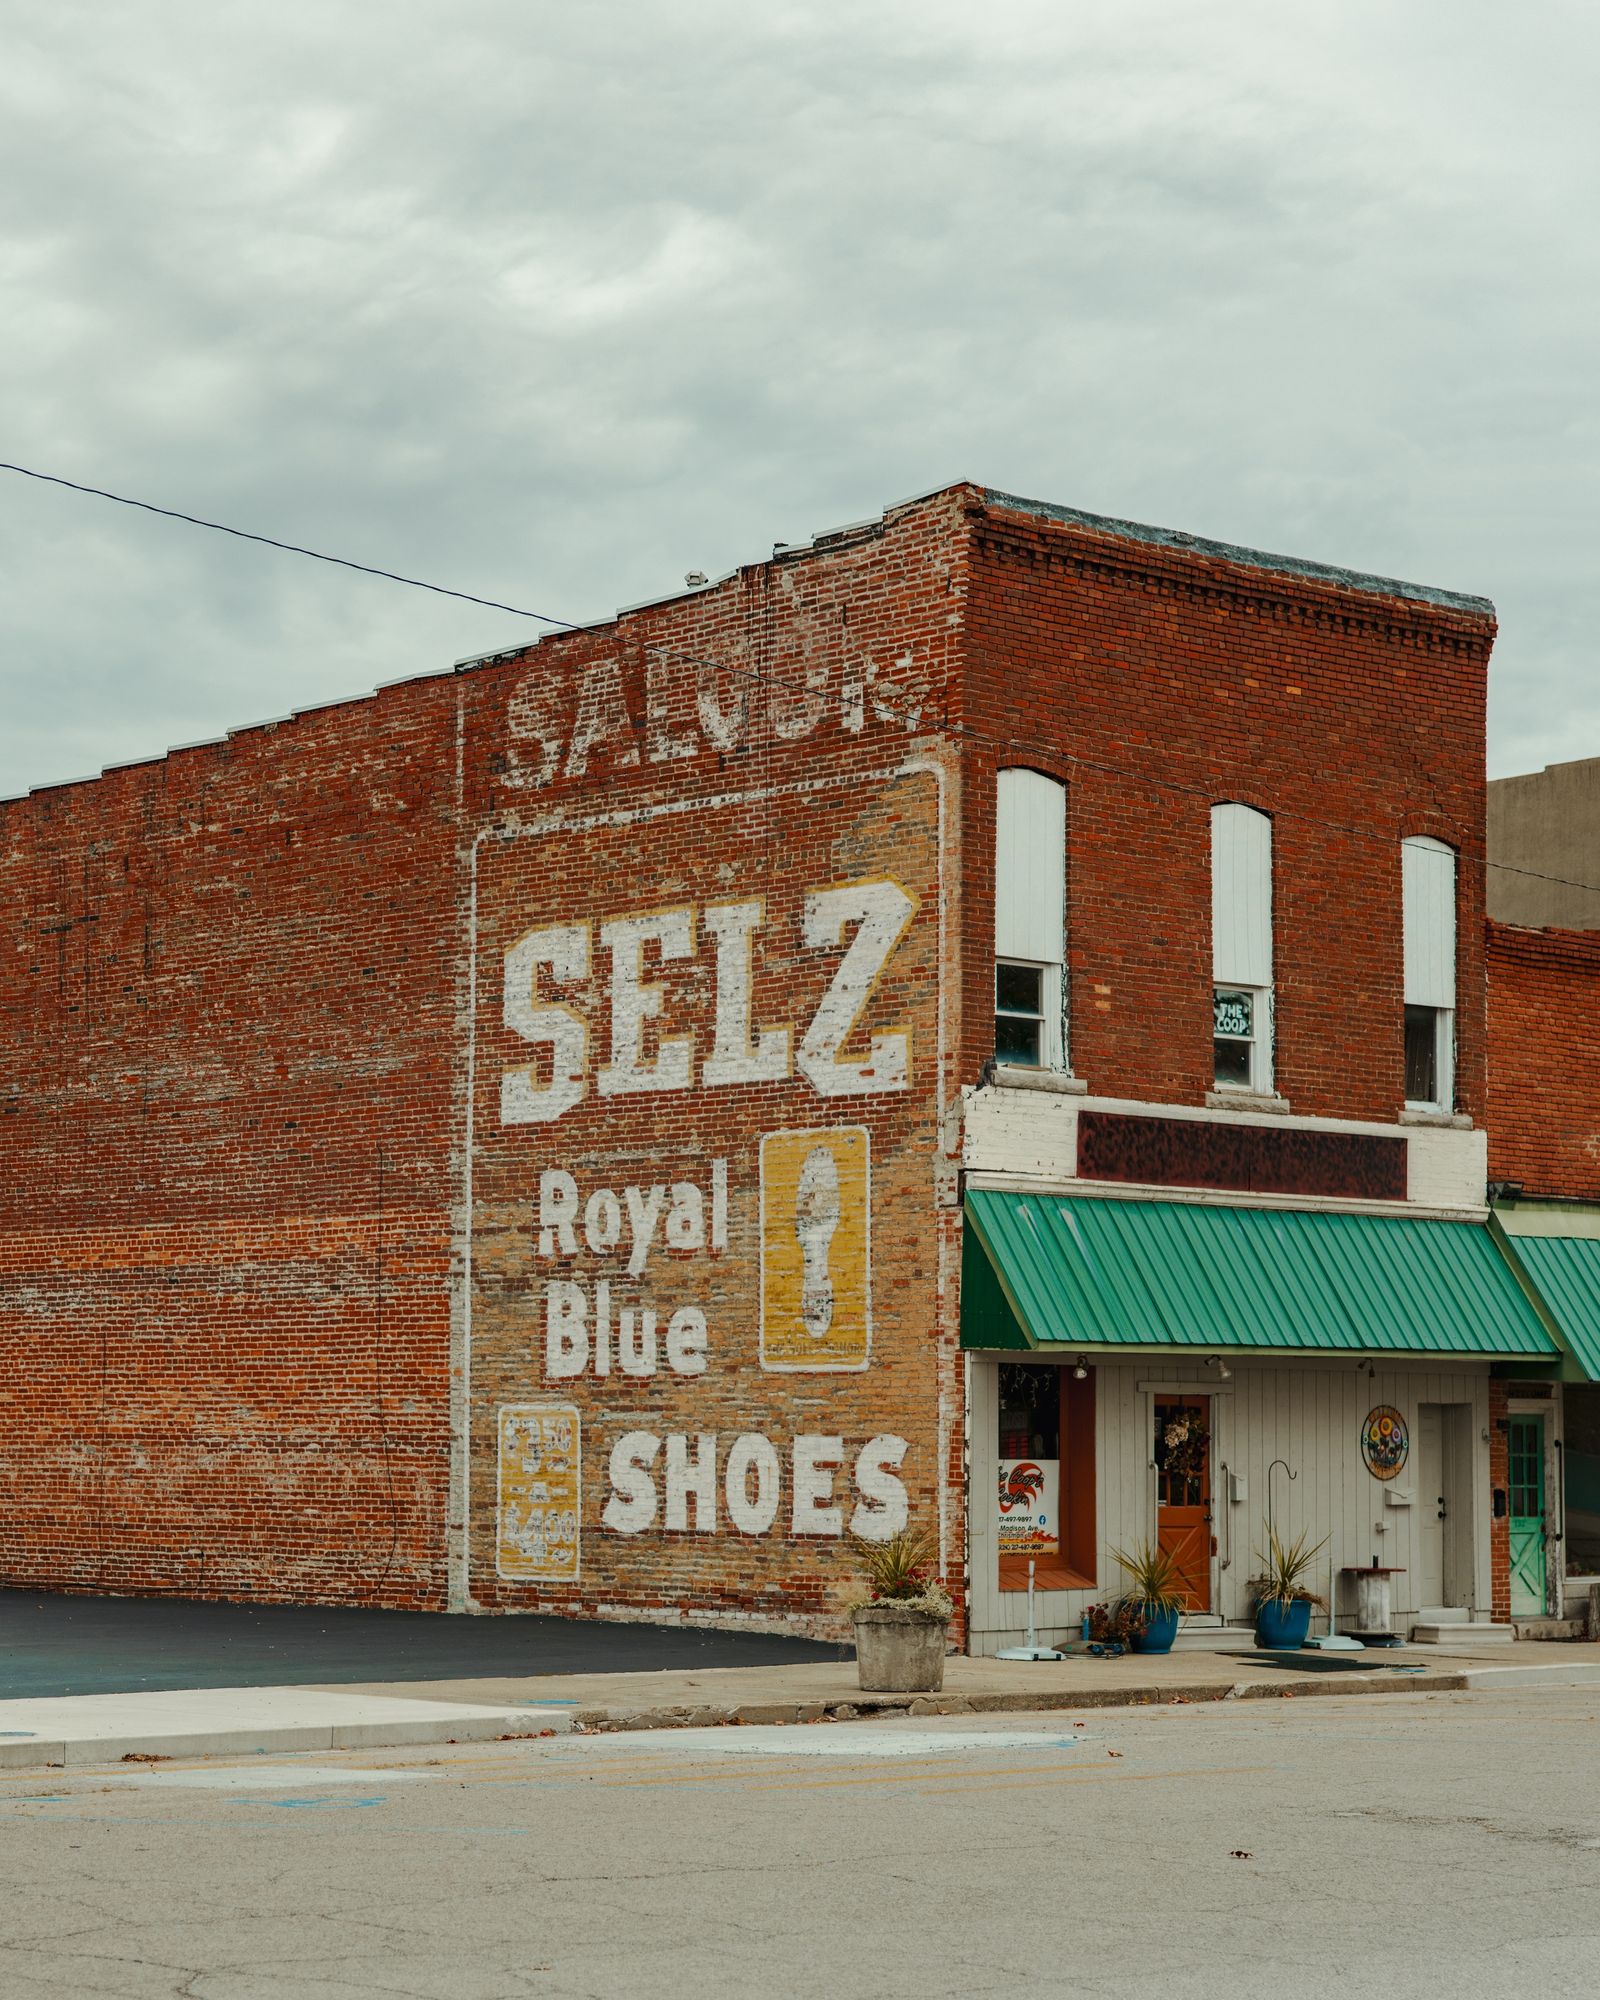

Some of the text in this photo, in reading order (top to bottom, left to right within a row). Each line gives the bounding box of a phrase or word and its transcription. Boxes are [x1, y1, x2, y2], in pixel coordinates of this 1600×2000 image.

[501, 874, 921, 1126] SELZ
[1217, 1016, 1247, 1034] COOP
[1220, 1003, 1243, 1018] THE
[539, 1158, 728, 1277] Royal
[545, 1280, 708, 1379] Blue
[601, 1432, 909, 1543] SHOES
[1009, 1467, 1045, 1488] Coop's
